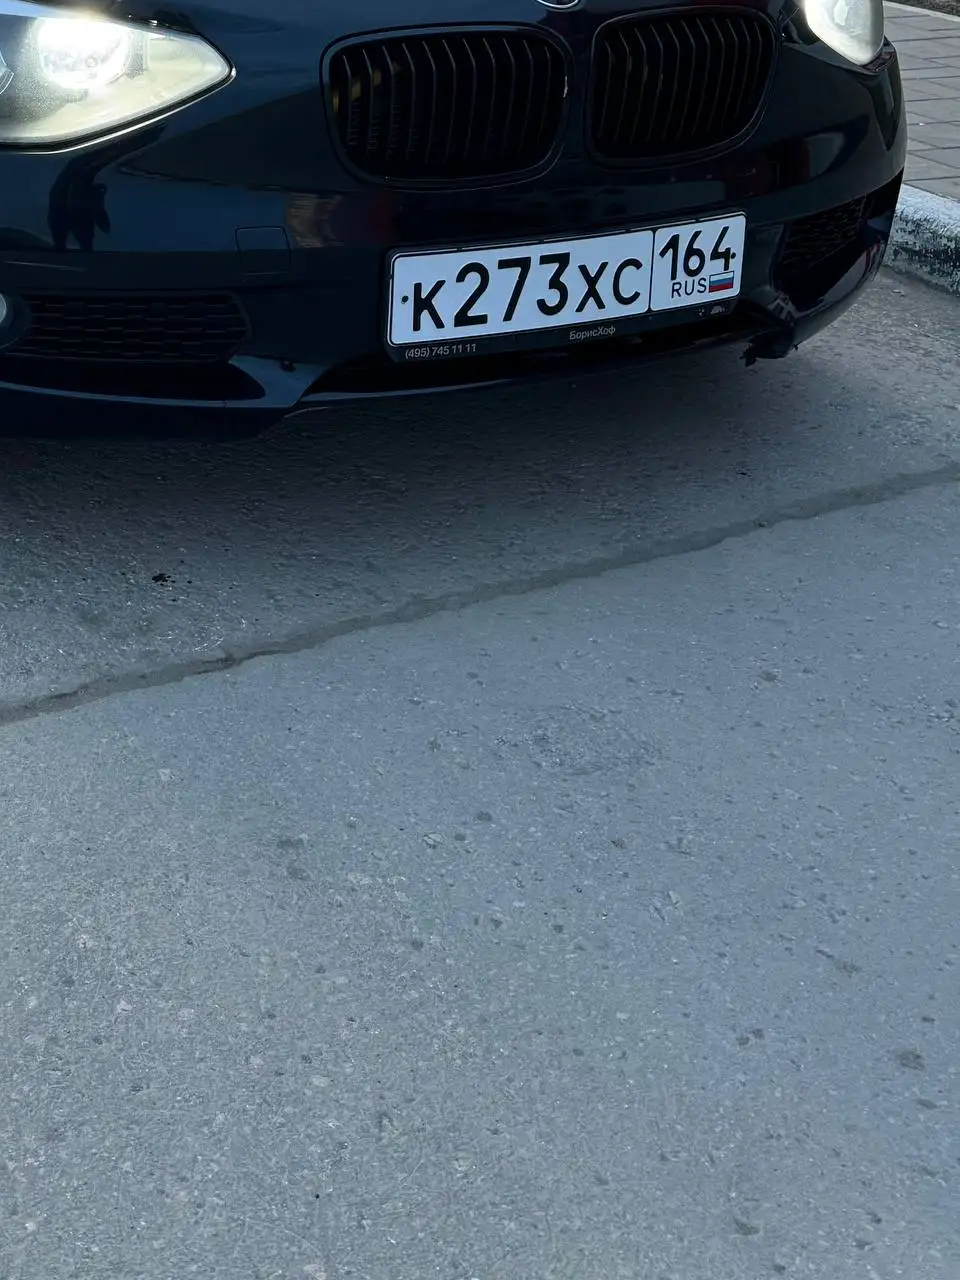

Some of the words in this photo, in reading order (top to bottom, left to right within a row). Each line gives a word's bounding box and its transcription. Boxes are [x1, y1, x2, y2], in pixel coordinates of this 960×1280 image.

[659, 225, 733, 281] 164
[671, 273, 708, 298] RUS
[569, 324, 616, 340] БорисХоф
[405, 345, 430, 360] (495)
[431, 345, 450, 357] 745
[452, 344, 463, 354] 11
[465, 343, 476, 353] 11
